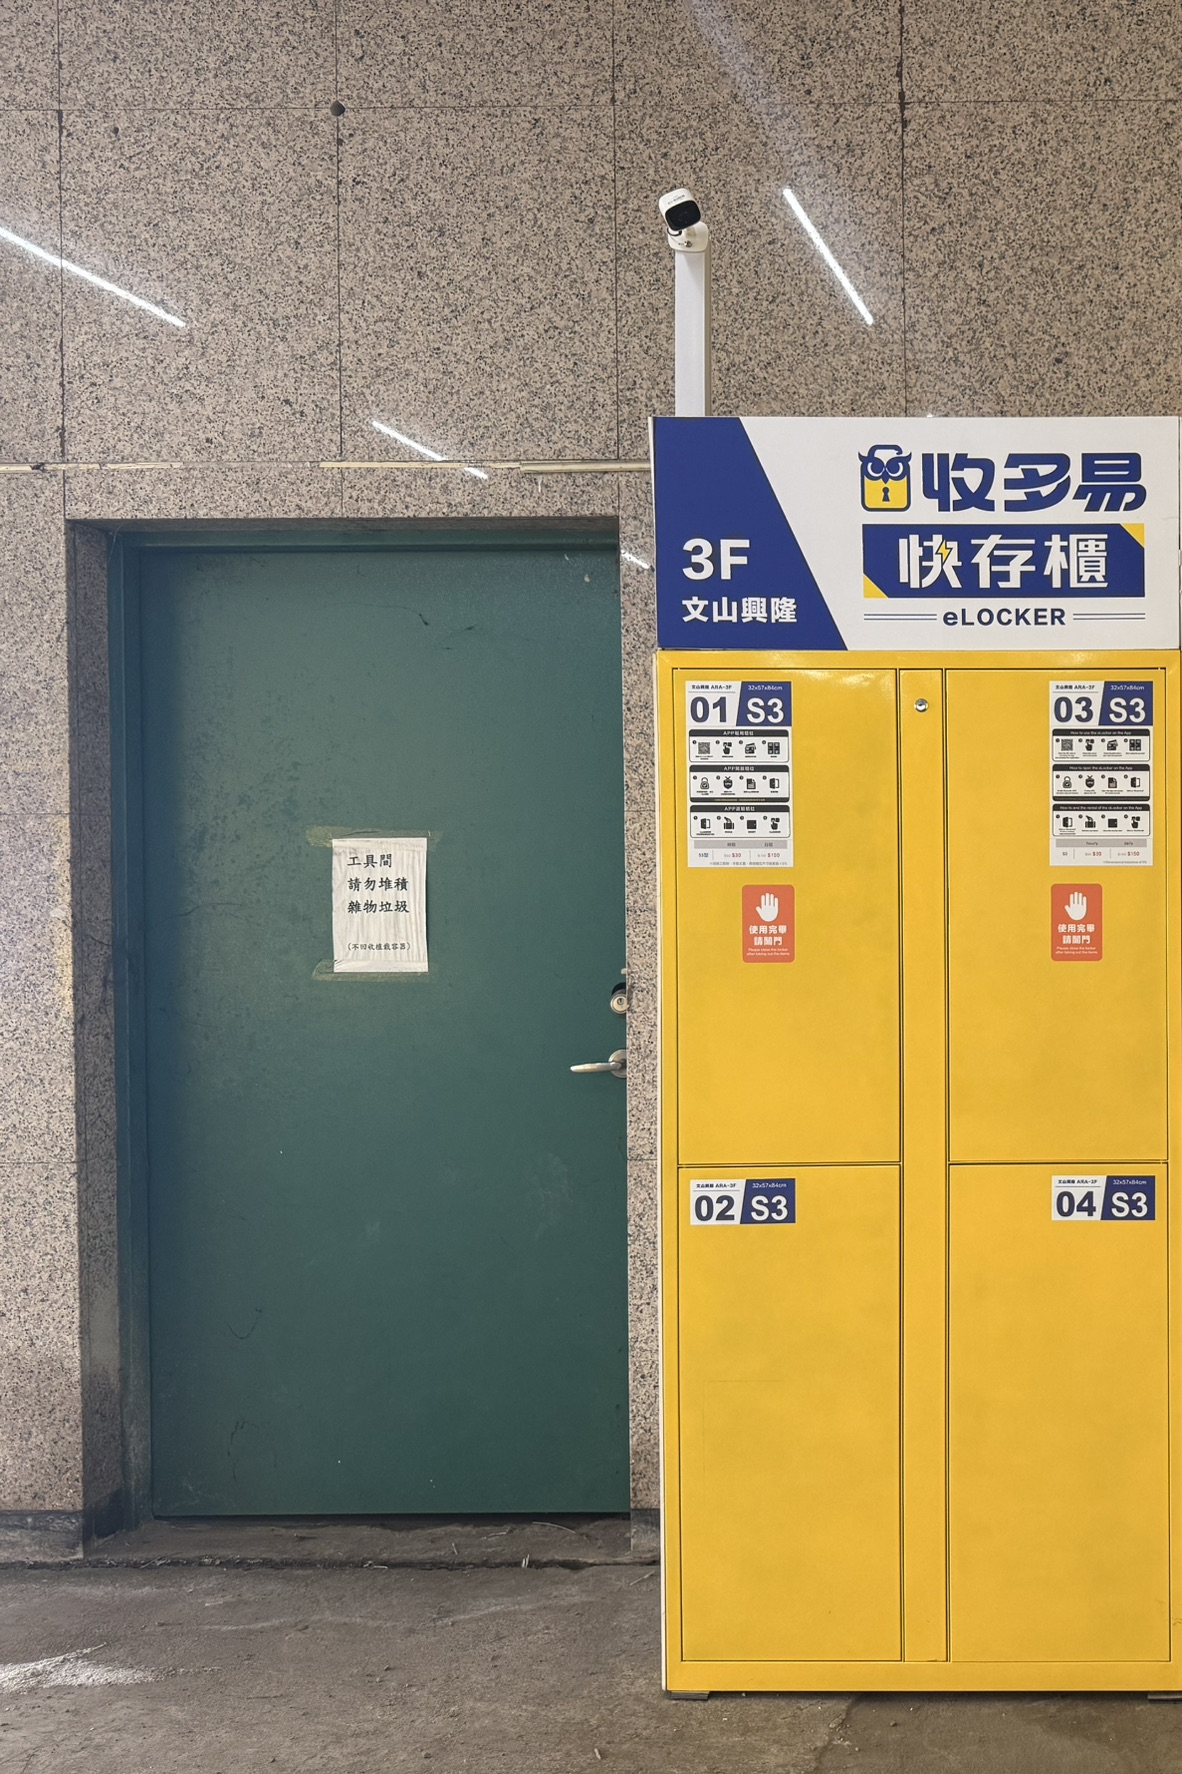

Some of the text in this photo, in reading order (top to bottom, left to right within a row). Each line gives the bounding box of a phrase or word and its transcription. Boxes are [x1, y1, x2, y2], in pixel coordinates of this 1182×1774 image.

[921, 452, 1147, 512] 收多易
[682, 538, 751, 581] 3F
[898, 533, 1110, 589] 快存櫃
[682, 596, 798, 624] 文山興隆
[942, 608, 1067, 626] eLOCKER
[690, 696, 784, 723] 01 S3
[1054, 696, 1146, 723] 03 S3
[347, 854, 393, 868] 工具間
[347, 877, 409, 892] 請勿堆積
[347, 900, 410, 914] 雜物垃圾
[695, 1195, 788, 1221] 02 S3
[1056, 1191, 1148, 1217] 04 S3
